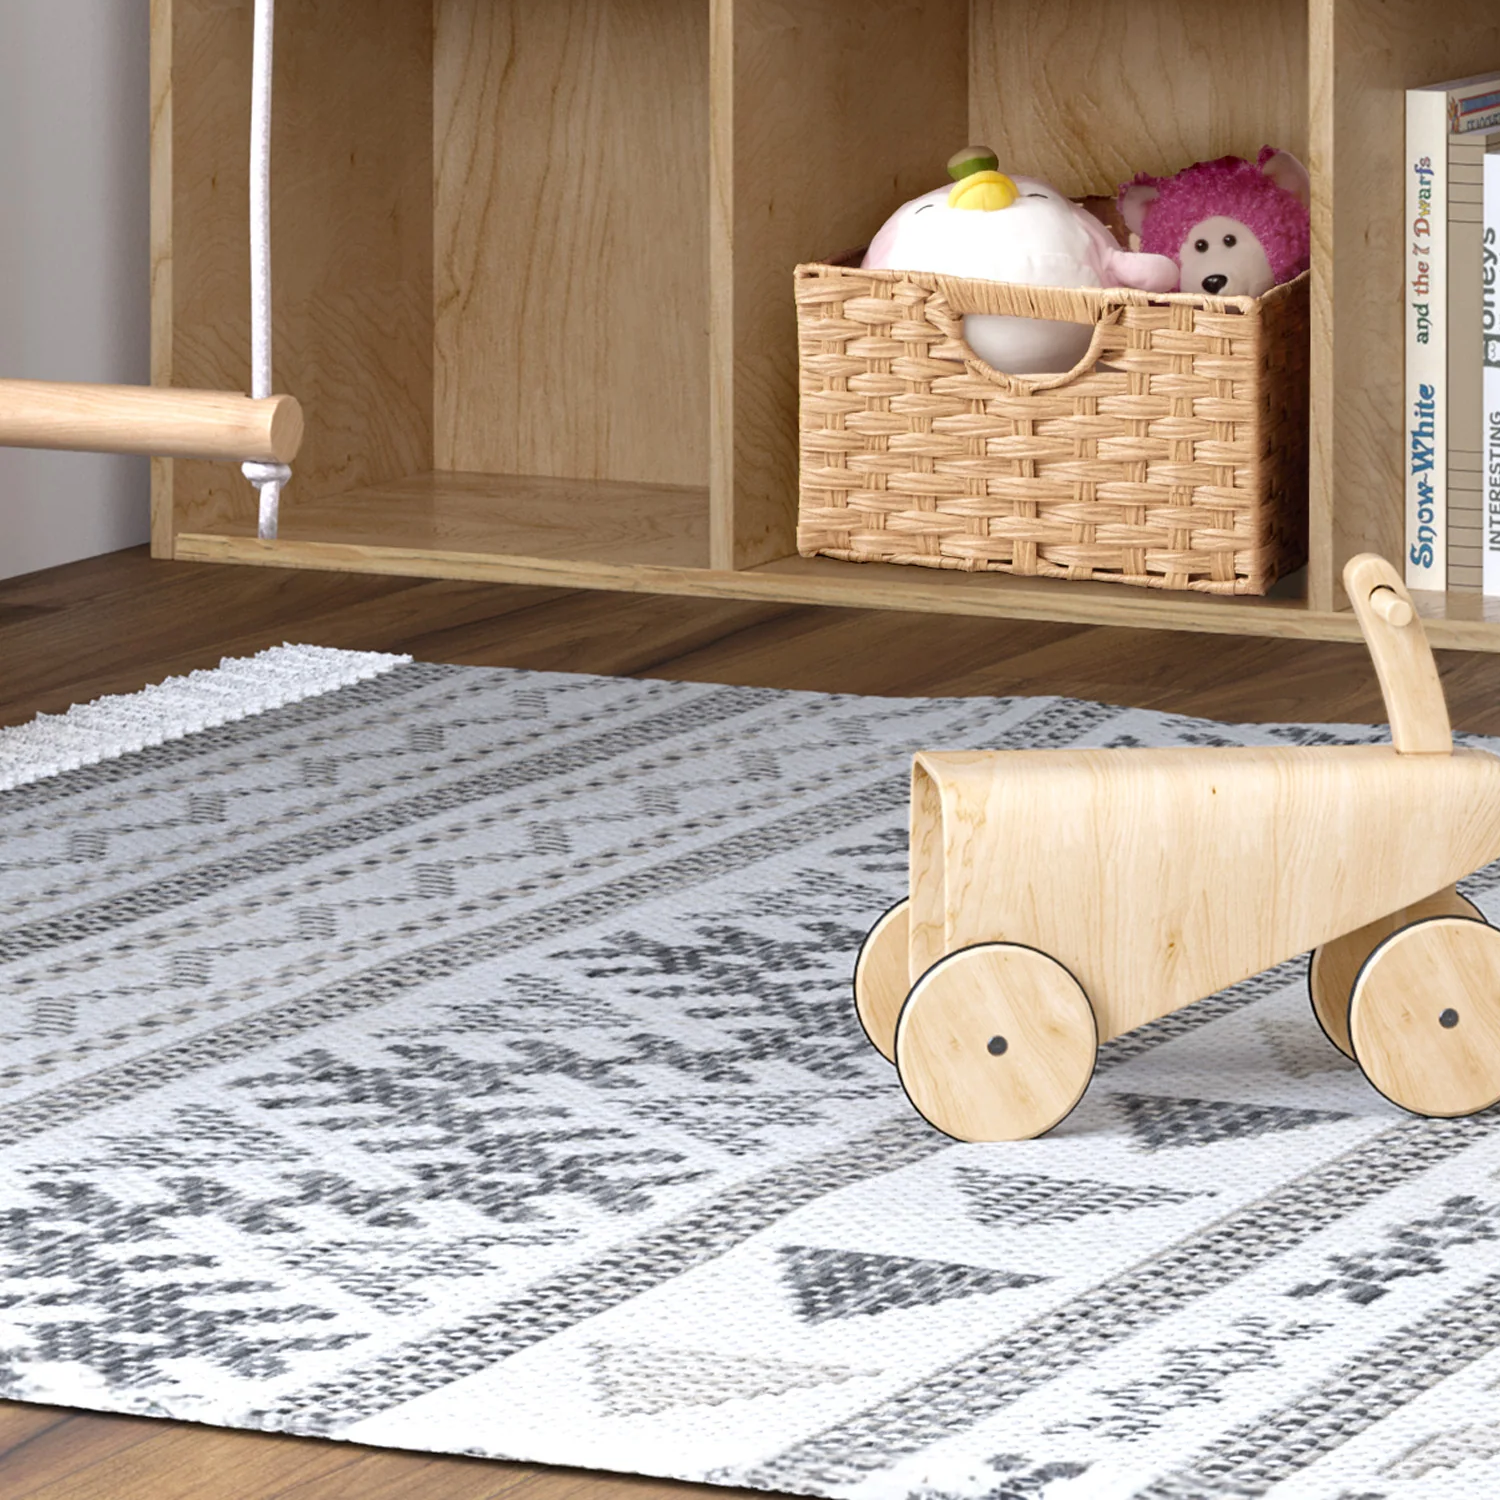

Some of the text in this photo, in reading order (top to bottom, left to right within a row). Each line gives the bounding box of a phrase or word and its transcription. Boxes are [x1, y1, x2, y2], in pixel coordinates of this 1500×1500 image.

[1410, 157, 1437, 568] Snow-White and the 7 Dwarfs
